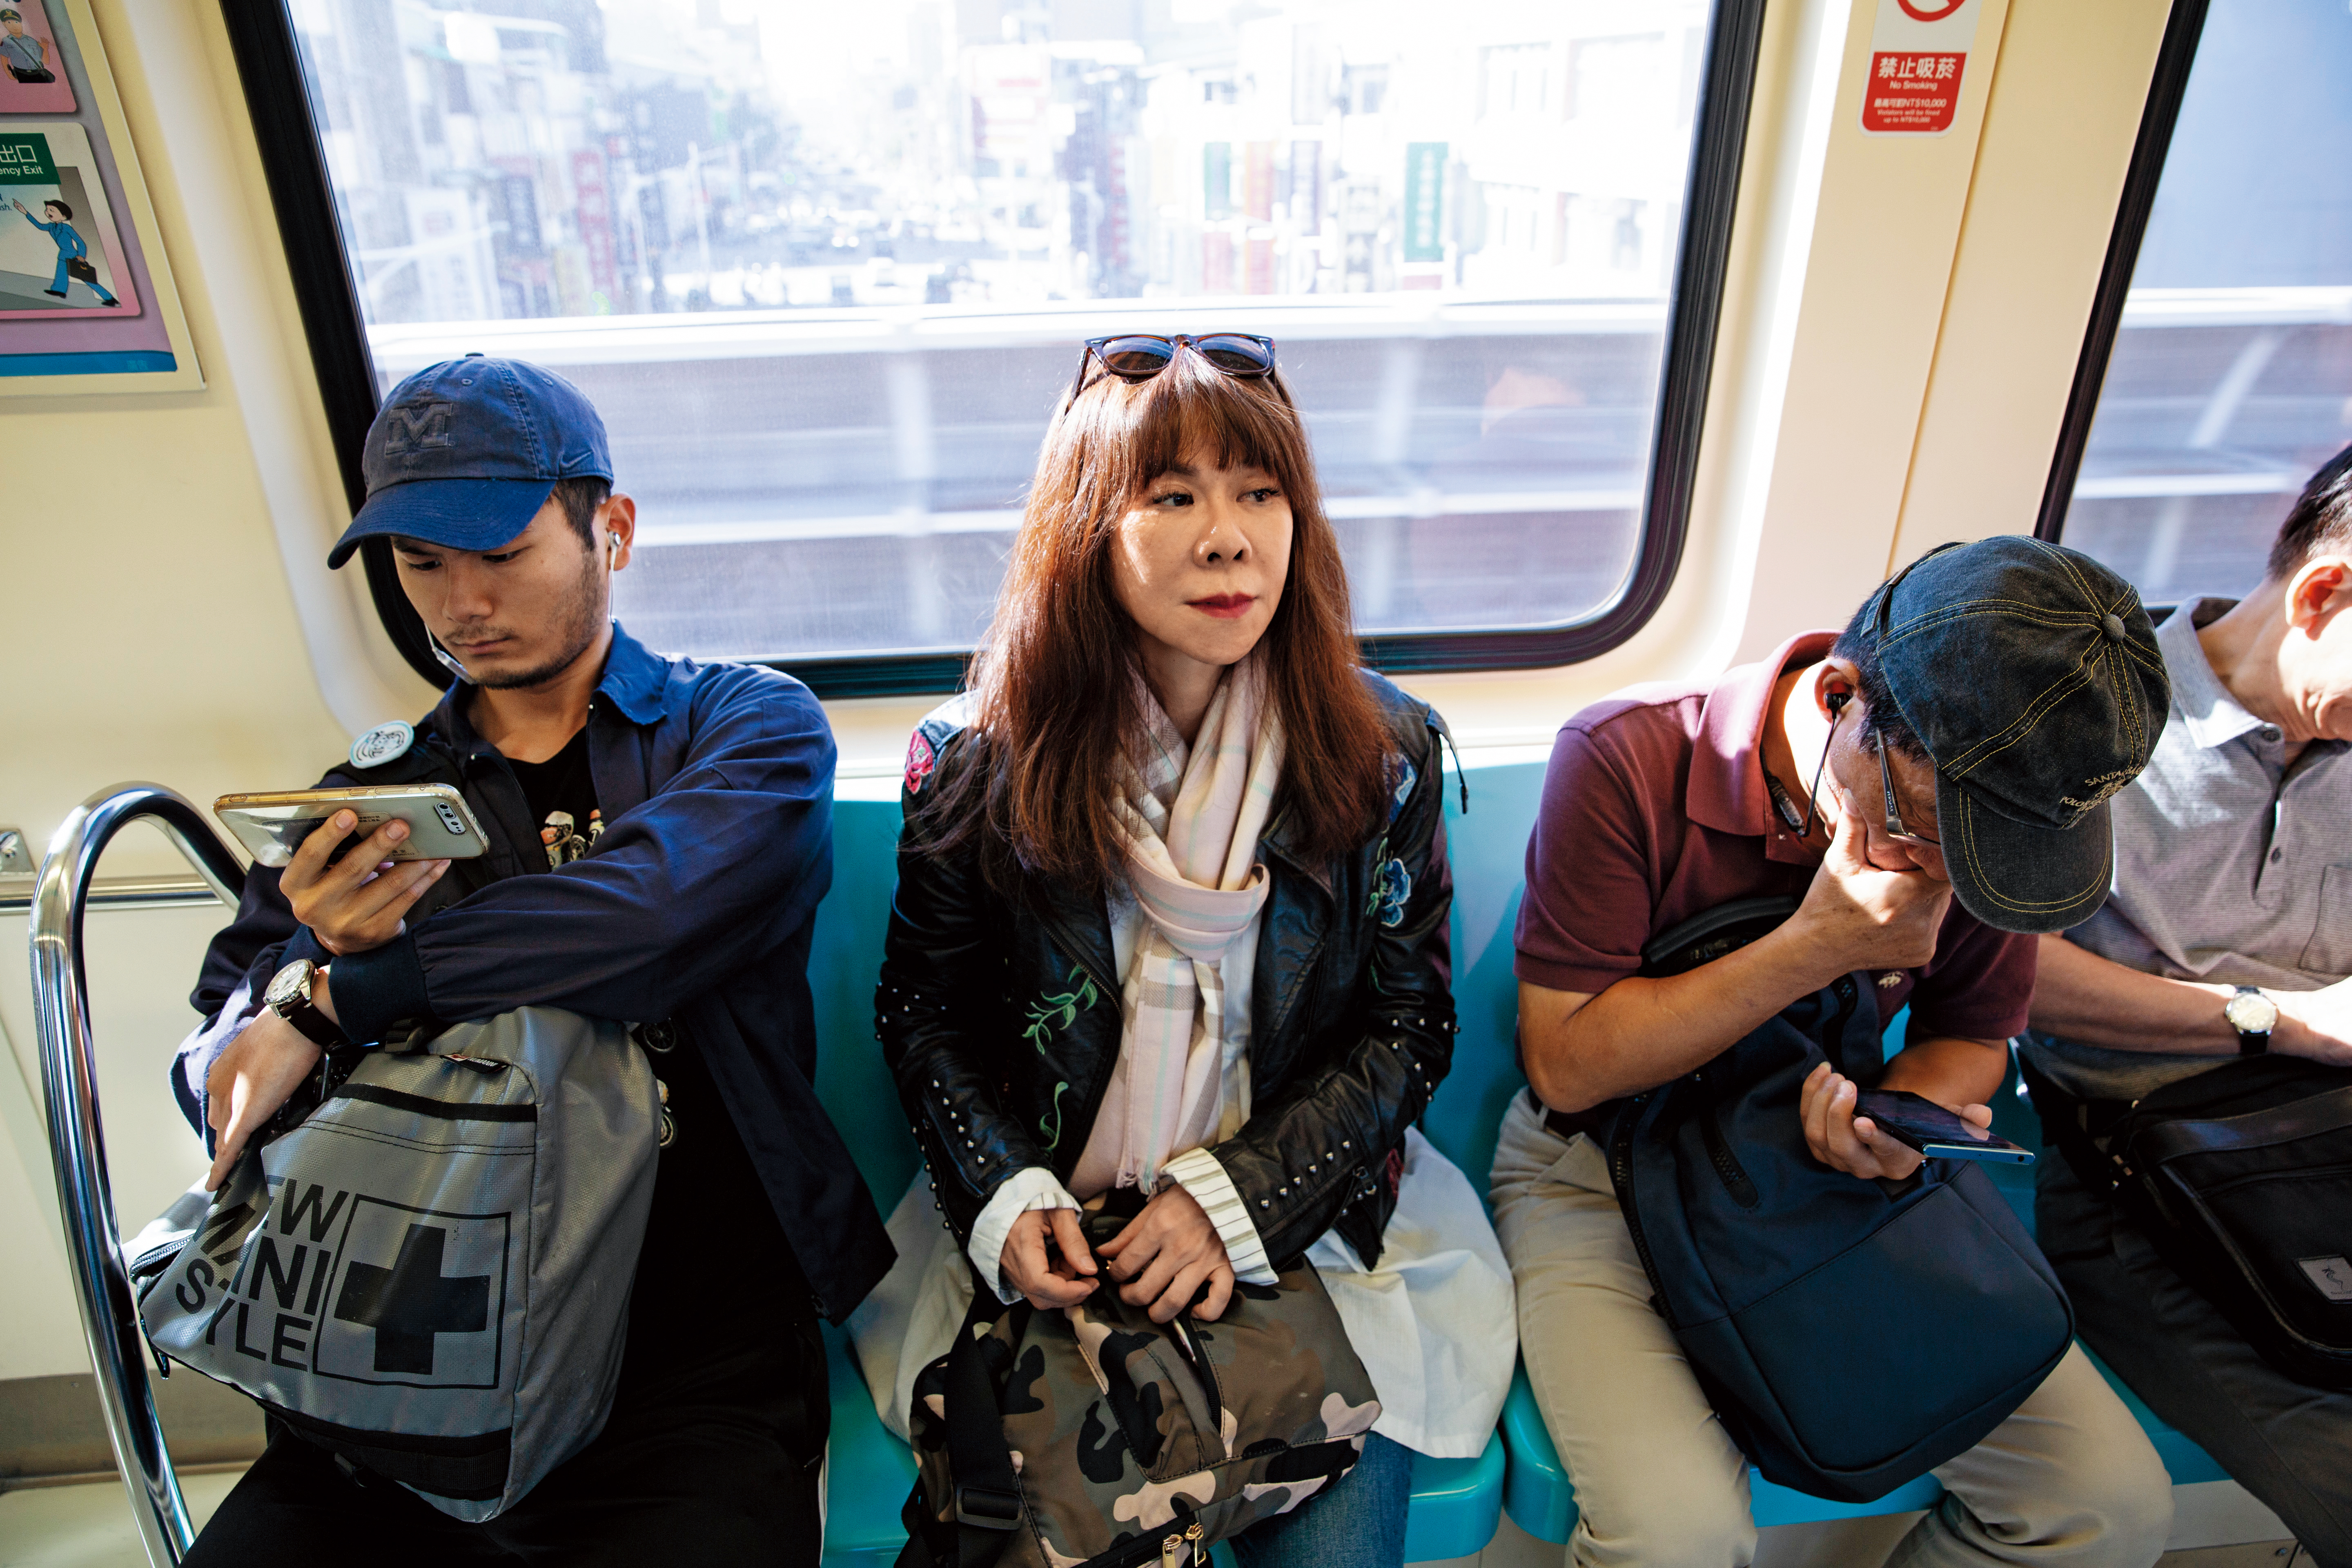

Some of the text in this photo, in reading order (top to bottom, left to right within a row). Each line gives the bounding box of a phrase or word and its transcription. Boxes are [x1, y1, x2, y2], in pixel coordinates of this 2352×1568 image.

[1878, 56, 1956, 79] 禁止吸菸
[1889, 80, 1938, 92] No Smoking
[23, 166, 44, 174] Exit
[383, 403, 453, 457] M
[2085, 771, 2122, 786] SANTA
[2060, 796, 2085, 807] POLO
